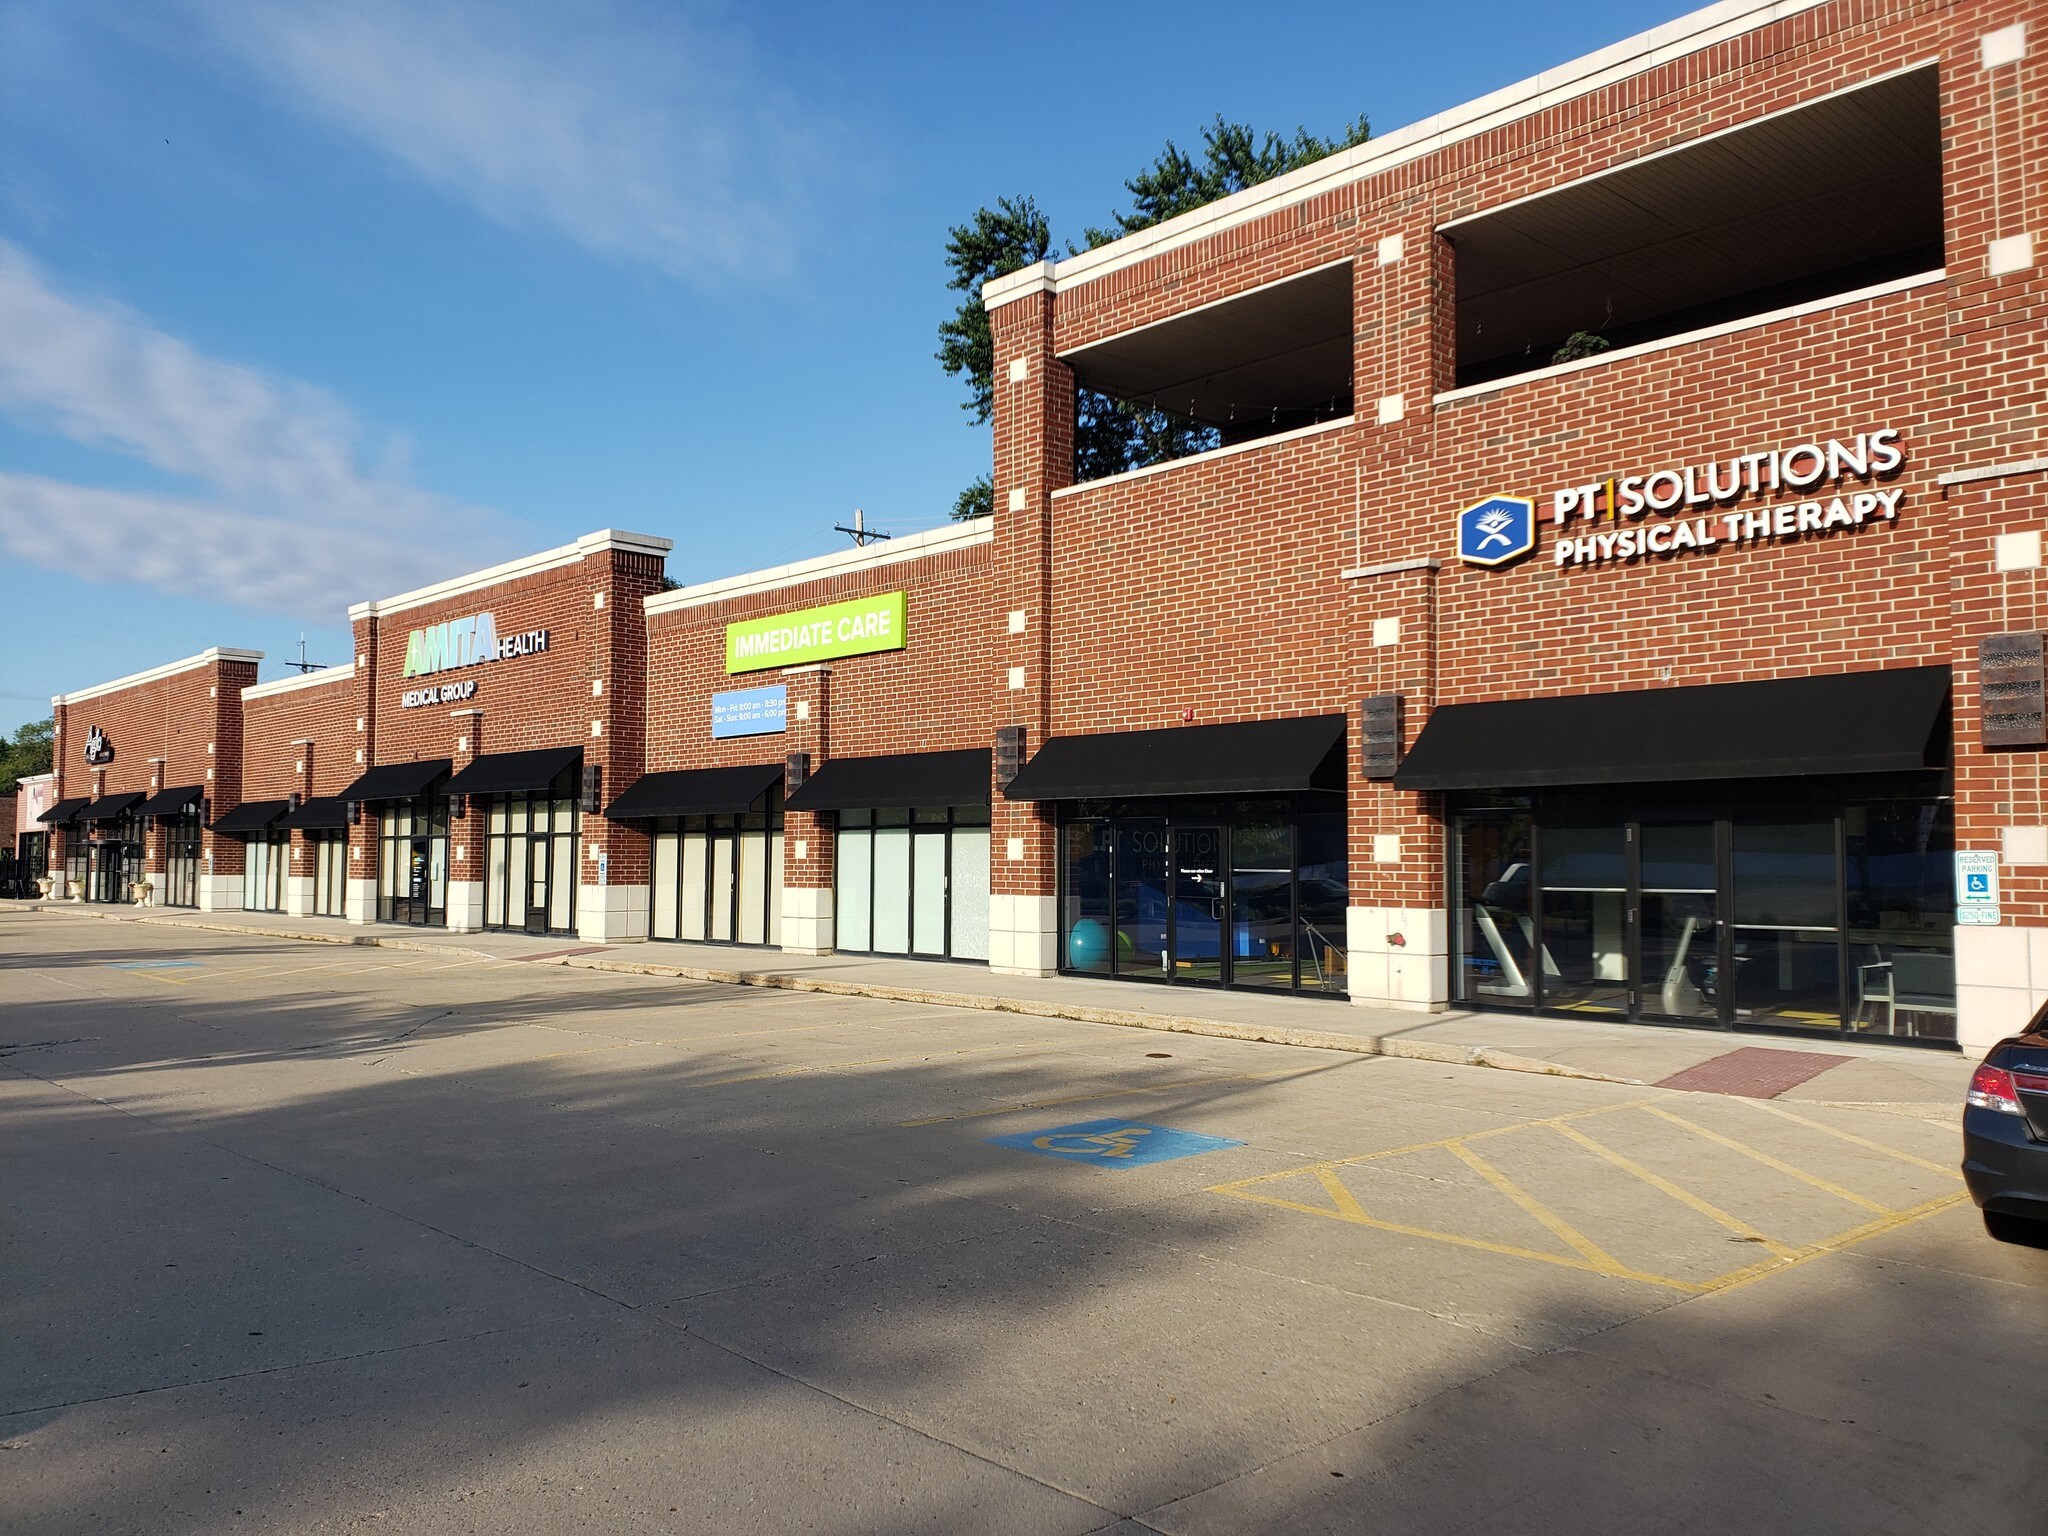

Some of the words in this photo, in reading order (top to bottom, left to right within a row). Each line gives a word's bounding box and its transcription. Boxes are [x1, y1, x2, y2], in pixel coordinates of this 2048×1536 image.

[1555, 517, 1716, 567] PHYSICAL
[1727, 488, 1903, 541] THERAPY
[735, 620, 833, 659] IMMEDIATE
[837, 609, 891, 642] CARE
[403, 612, 499, 678] AMITA
[497, 629, 547, 660] HEALTH
[401, 687, 439, 709] MEDICAL
[440, 681, 475, 702] GROUP
[714, 705, 726, 714] Mon
[752, 702, 760, 710] am
[714, 715, 723, 724] Sat
[752, 712, 760, 720] am
[1960, 855, 1995, 864] RESERVED
[1962, 865, 1993, 873] PARKING
[1981, 911, 1997, 920] FINE
